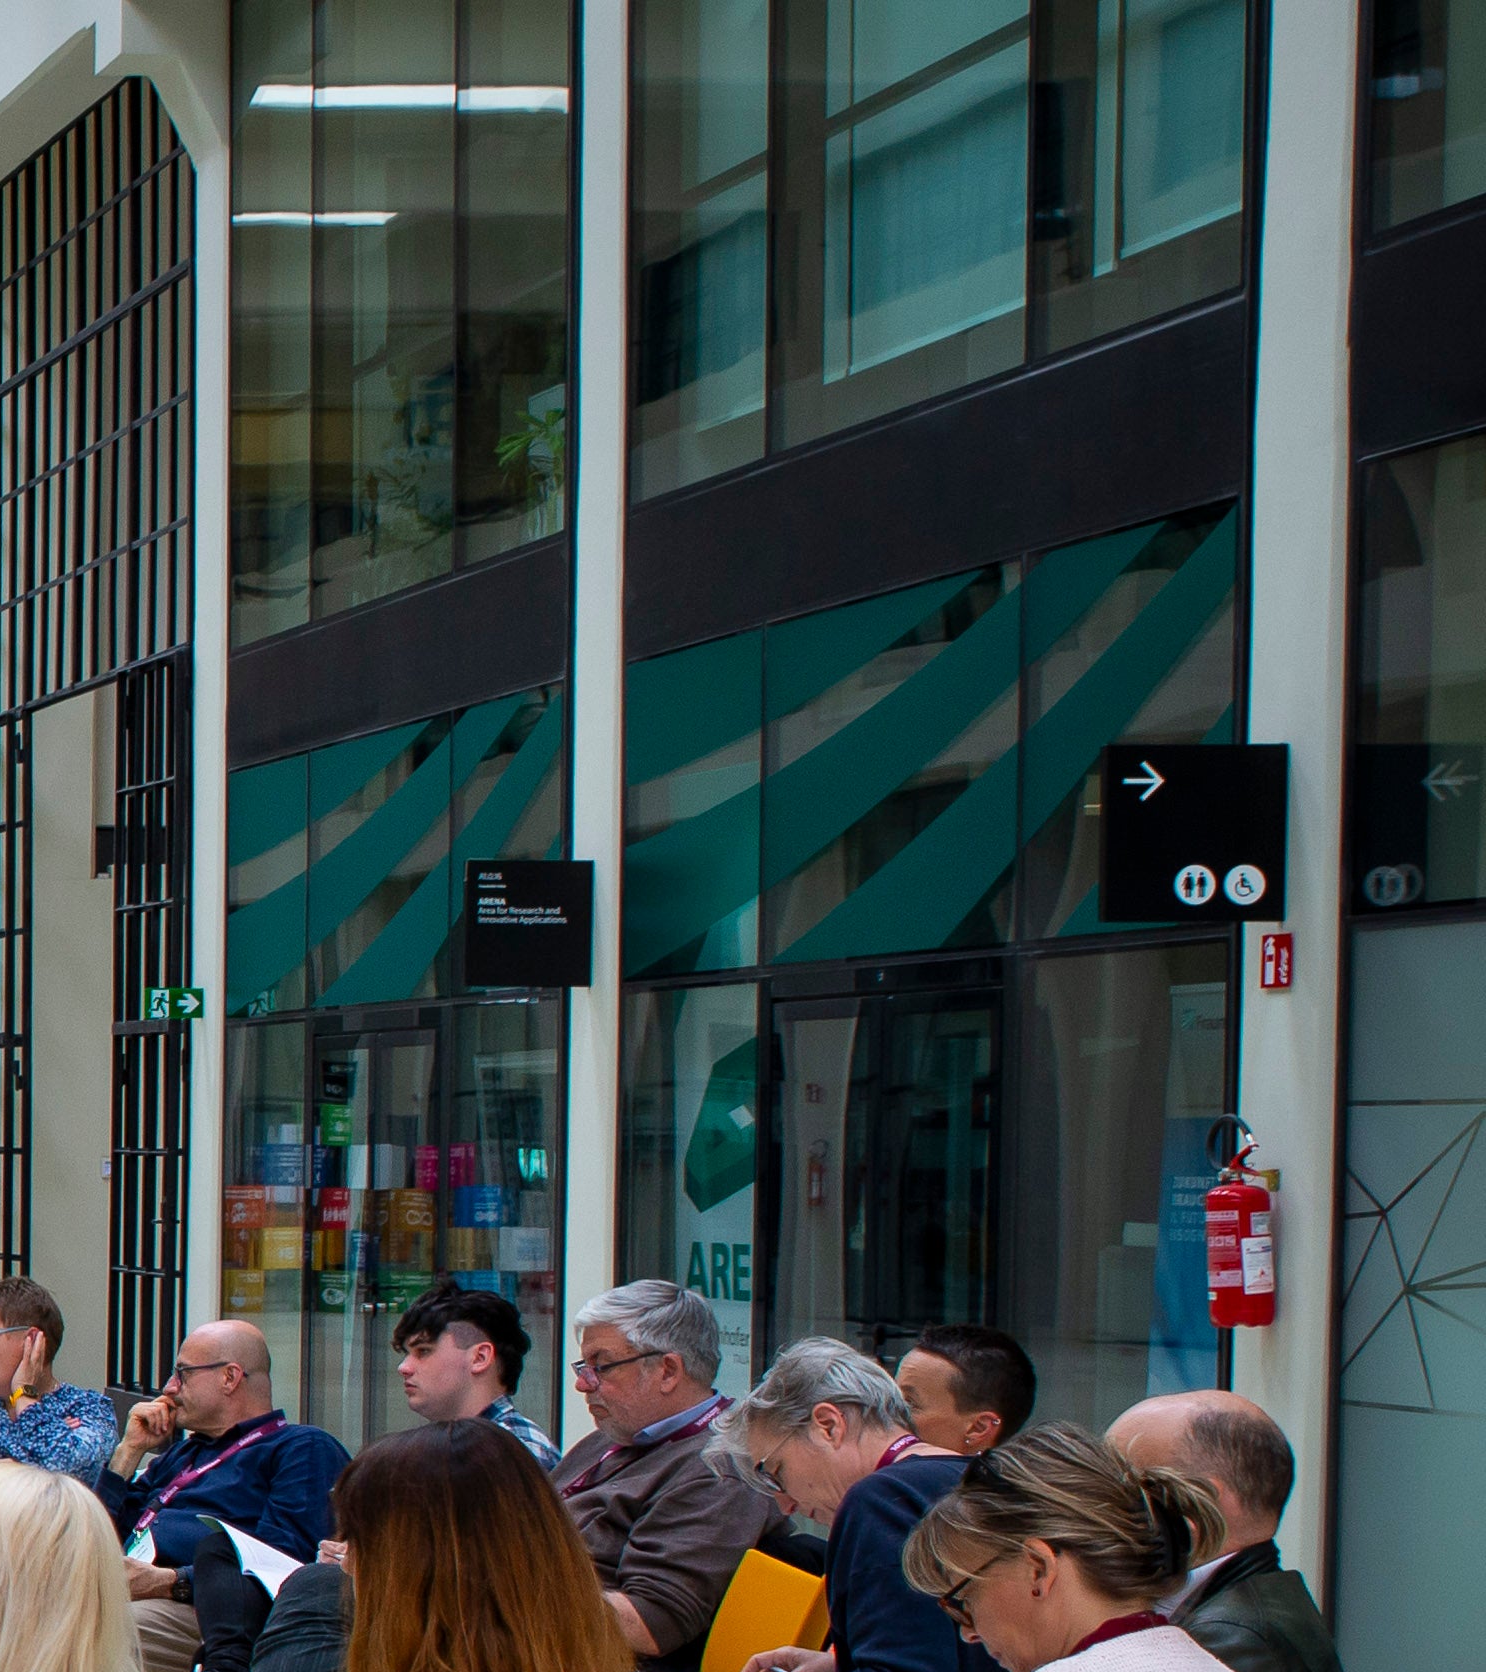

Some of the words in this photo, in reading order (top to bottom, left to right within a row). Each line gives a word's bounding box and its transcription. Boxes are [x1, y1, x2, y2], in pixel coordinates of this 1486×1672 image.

[478, 897, 506, 906] ARENA
[478, 906, 496, 914] Area
[496, 906, 507, 914] for
[508, 906, 544, 914] Research
[545, 906, 561, 914] and
[478, 916, 518, 924] Innovative
[519, 916, 568, 925] Applications
[686, 1242, 751, 1302] ARE
